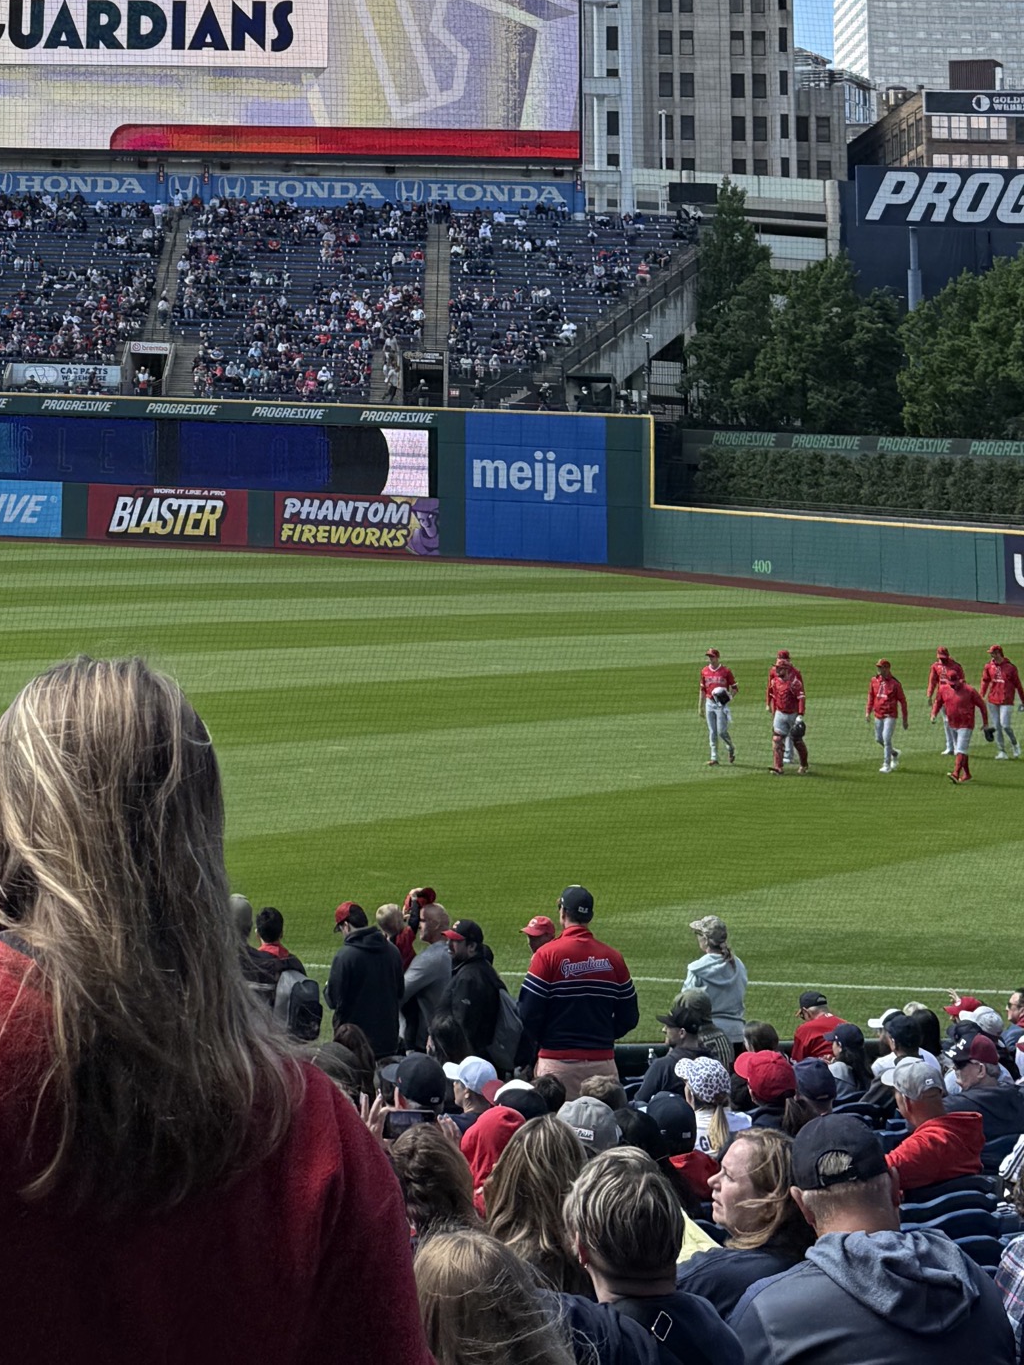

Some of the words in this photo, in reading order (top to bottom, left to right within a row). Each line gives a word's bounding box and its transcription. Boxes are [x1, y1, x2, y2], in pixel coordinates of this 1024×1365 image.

[16, 175, 146, 194] HONDA
[250, 180, 385, 200] HONDA
[428, 183, 568, 203] HONDA
[41, 399, 113, 412] PROGRESSIVE
[146, 402, 218, 416] PROGRESSIVE
[252, 406, 324, 420] PROGRESSIVE
[360, 410, 434, 424] PROGRESSIVE
[712, 431, 776, 447] PROGRESSIVE
[792, 434, 861, 450] PROGRESSIVE
[877, 437, 952, 453] PROGRESSIVE
[472, 450, 600, 502] meijer
[283, 497, 410, 525] PHANTOM
[280, 523, 407, 548] FIREWORKS
[752, 559, 772, 575] 400
[560, 956, 614, 979] Guardians
